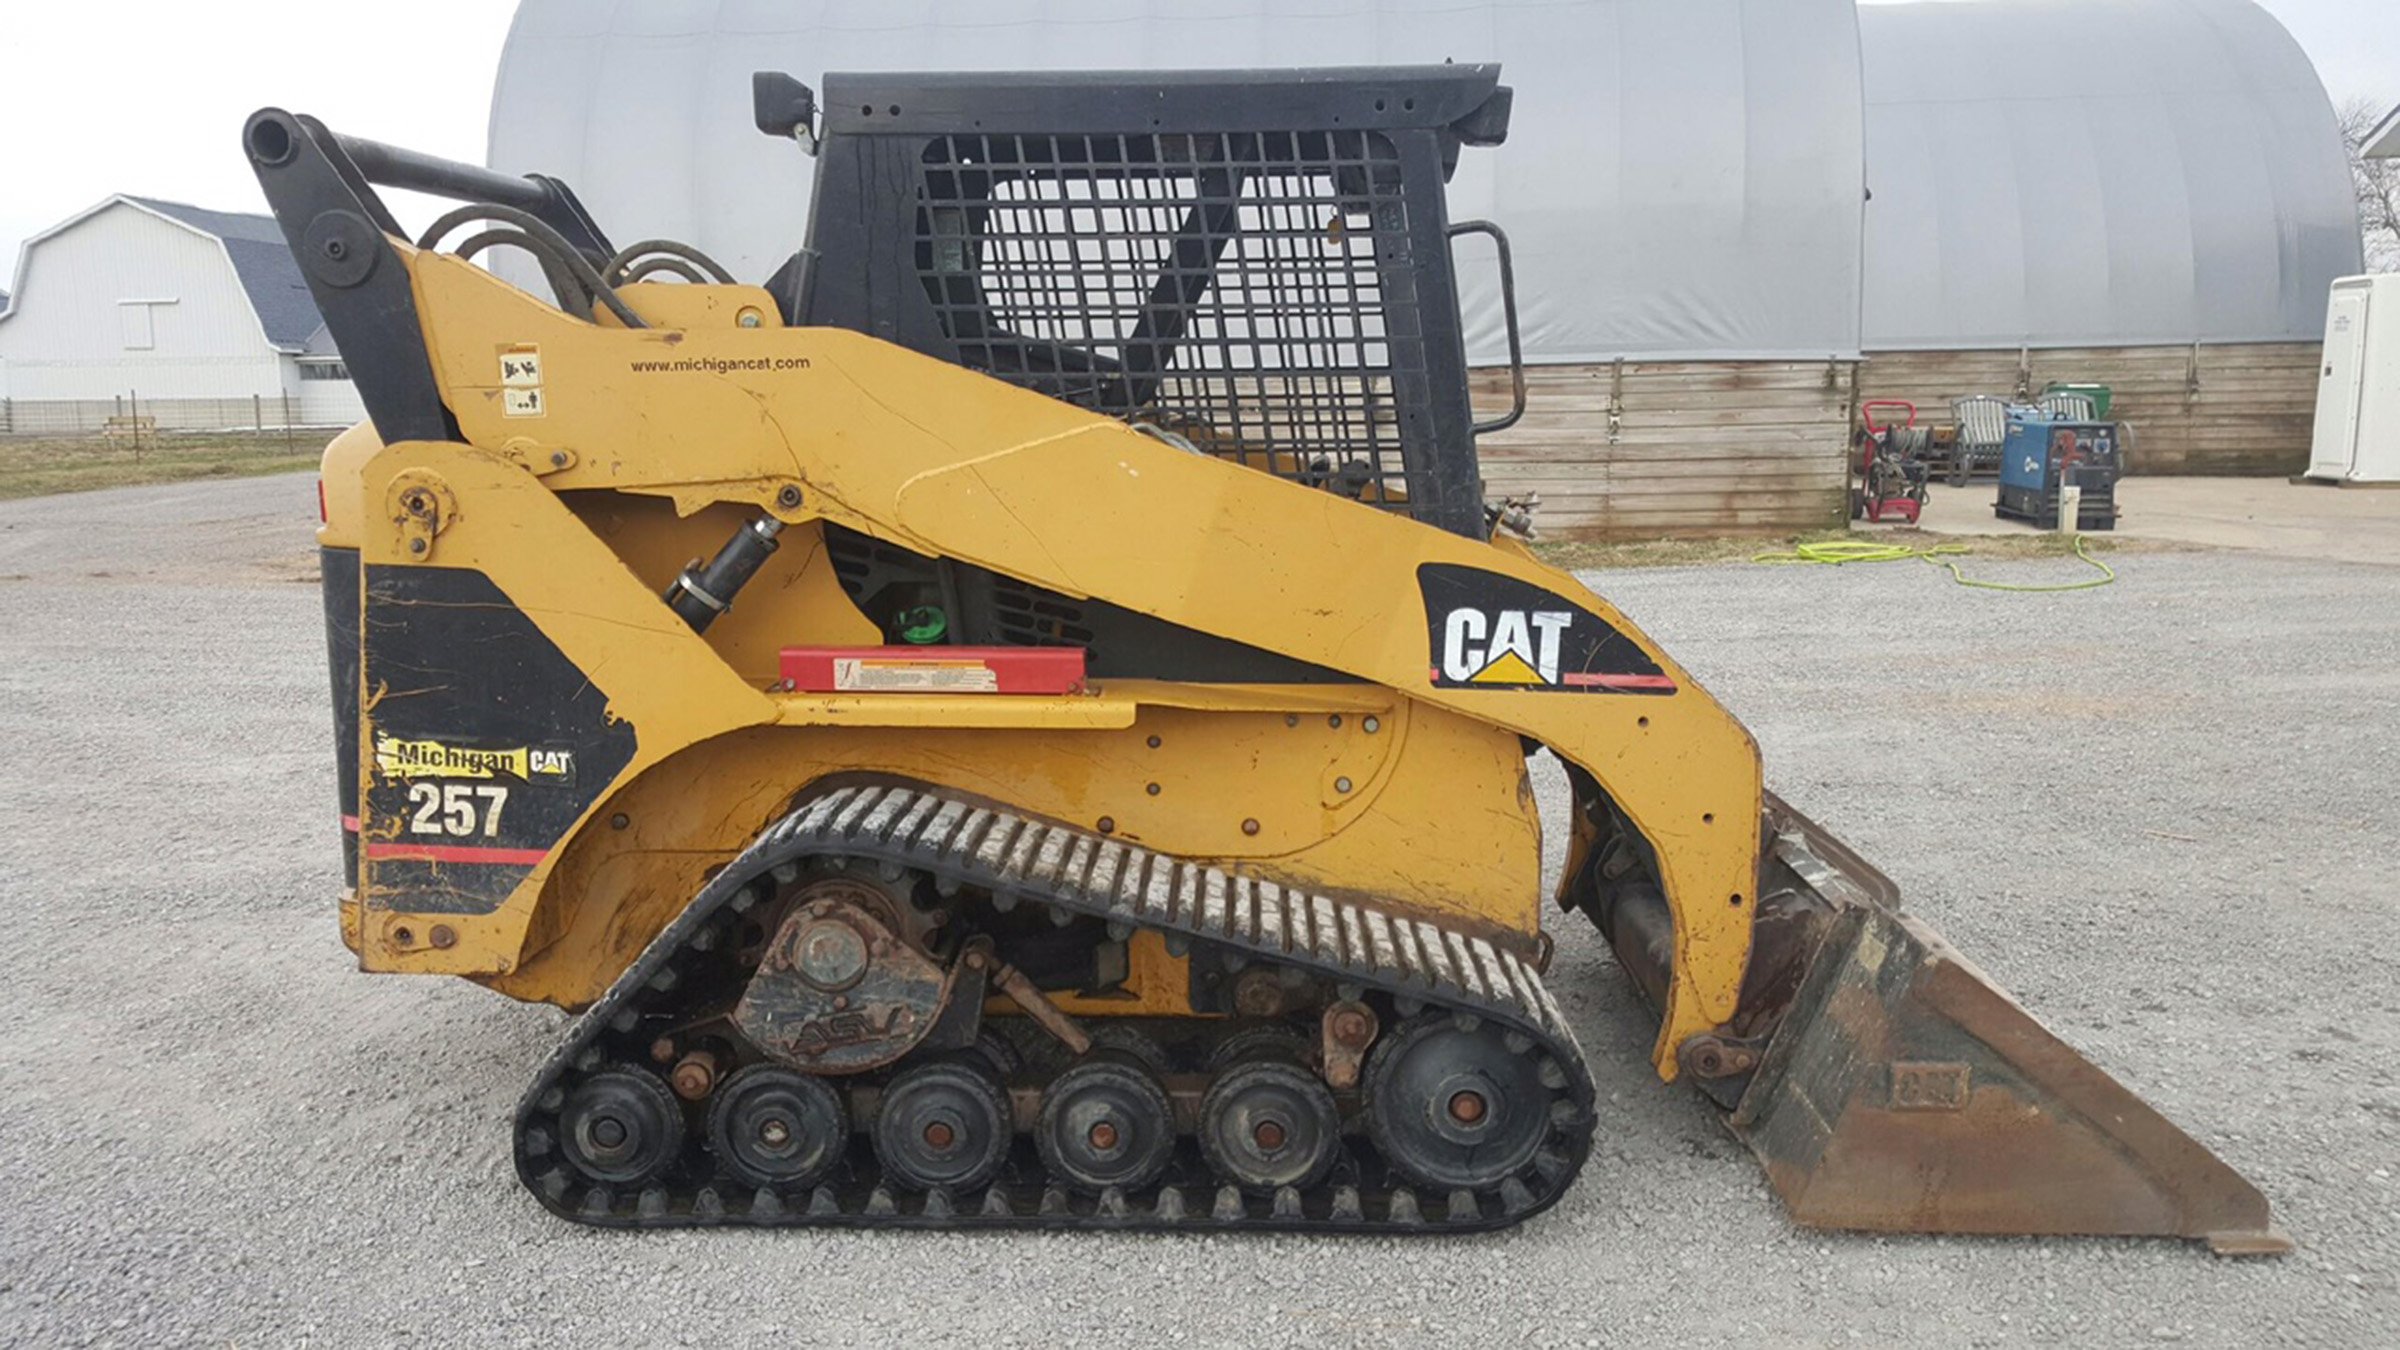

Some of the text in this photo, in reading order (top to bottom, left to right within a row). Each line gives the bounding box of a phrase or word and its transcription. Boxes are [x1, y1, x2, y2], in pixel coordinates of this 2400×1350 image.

[630, 357, 811, 375] www.michigancat.com
[1443, 606, 1573, 685] CAT
[397, 744, 571, 774] Michigan CAT
[409, 782, 508, 838] 257
